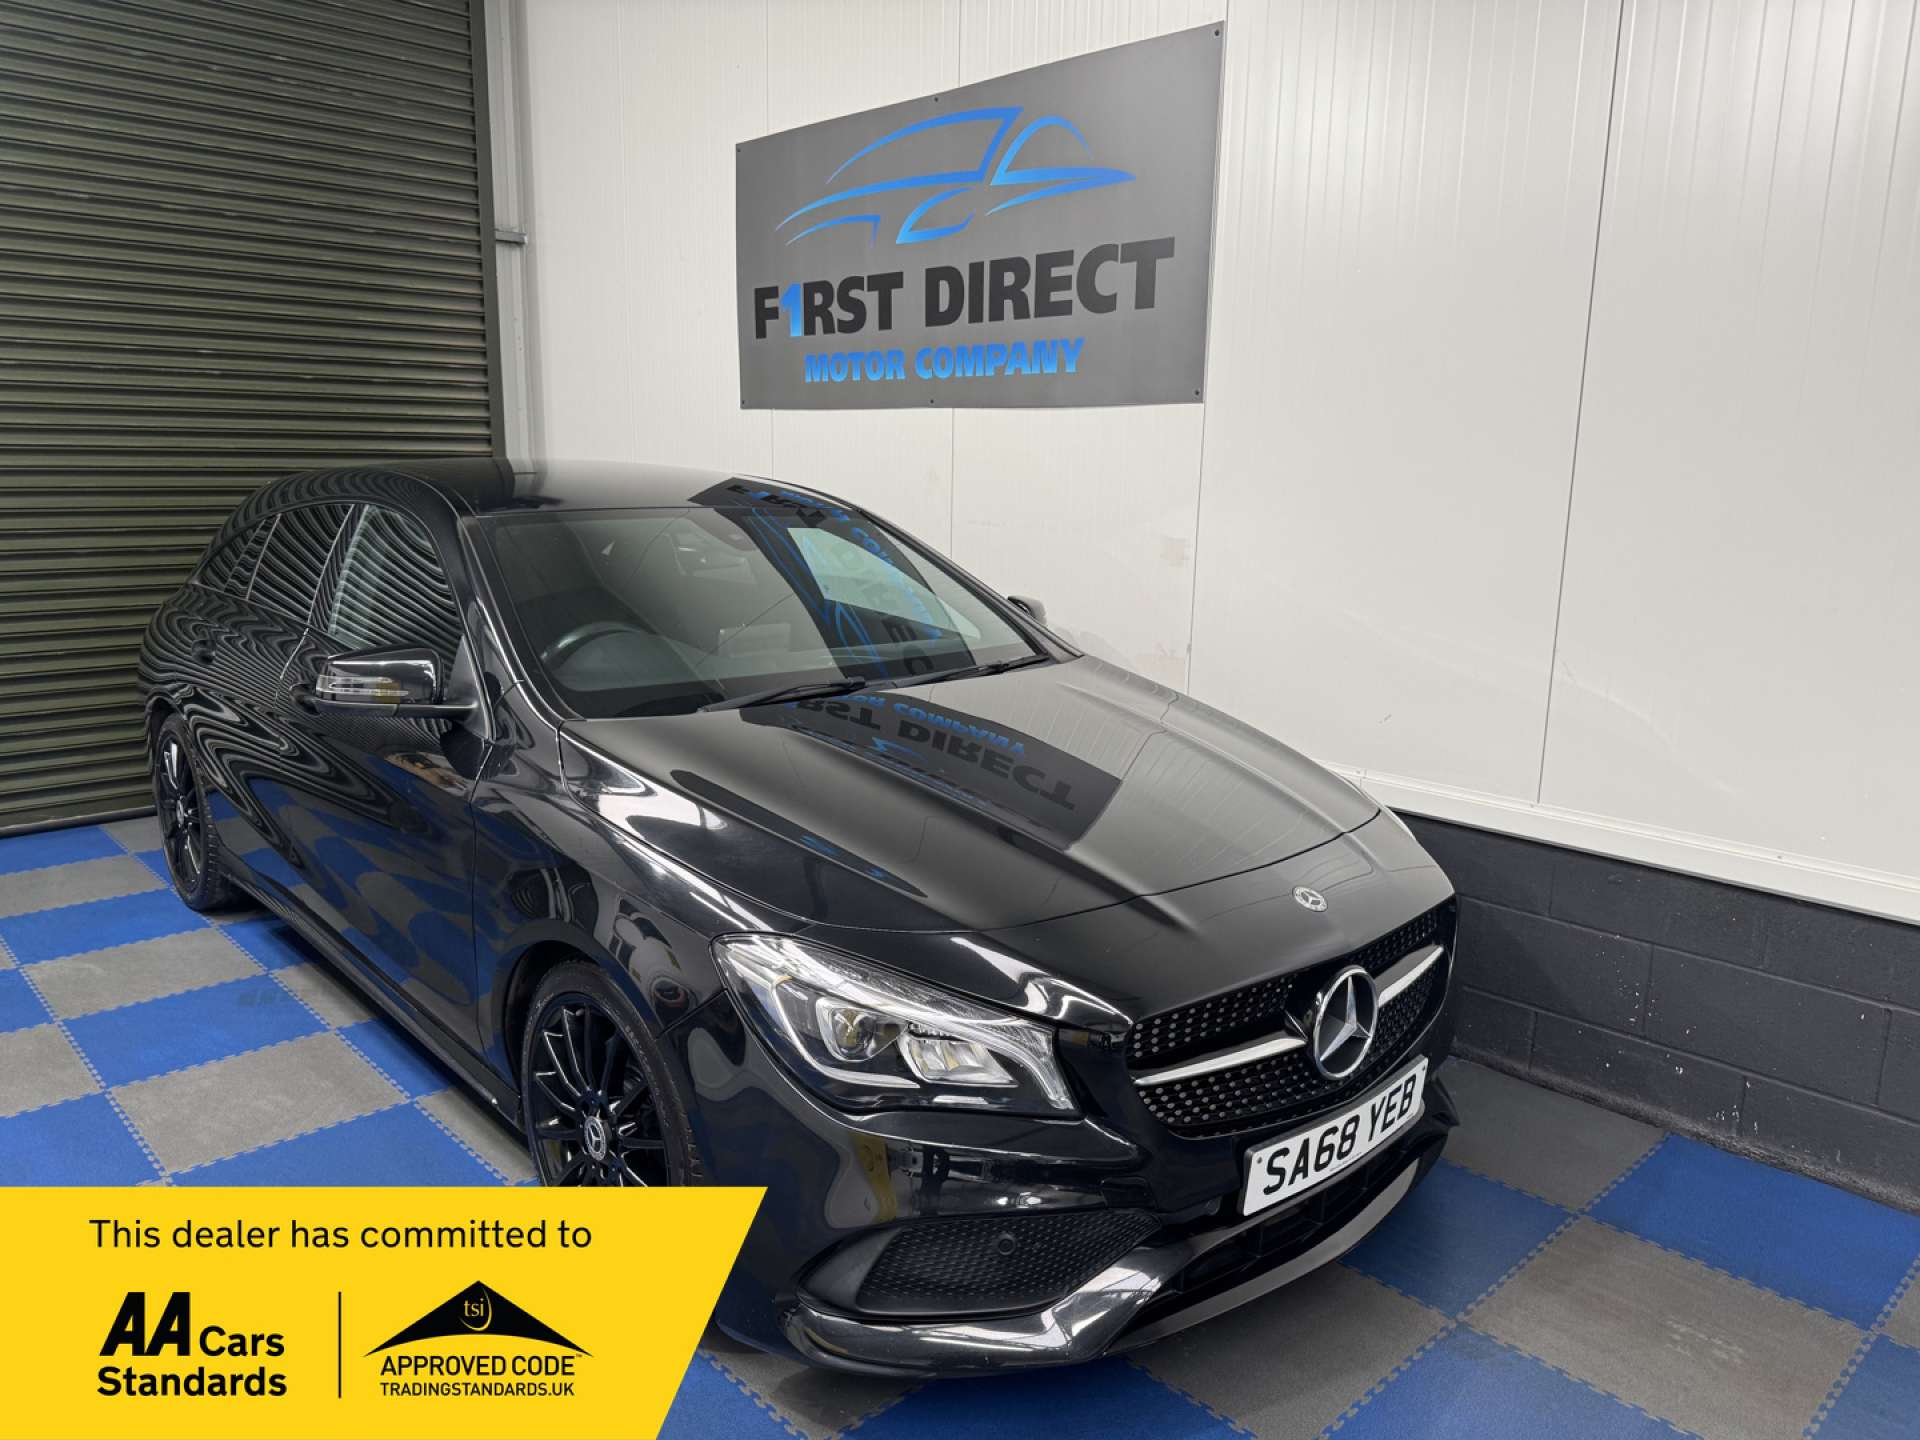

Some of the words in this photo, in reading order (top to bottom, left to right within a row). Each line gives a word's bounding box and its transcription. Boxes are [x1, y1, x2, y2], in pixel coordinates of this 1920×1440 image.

[754, 271, 904, 339] F1RST
[925, 236, 1175, 327] DIRECT
[804, 350, 906, 383] MOTOR
[915, 337, 1085, 379] COMPANY
[1263, 1114, 1361, 1196] SA68
[1367, 1074, 1417, 1142] YEB
